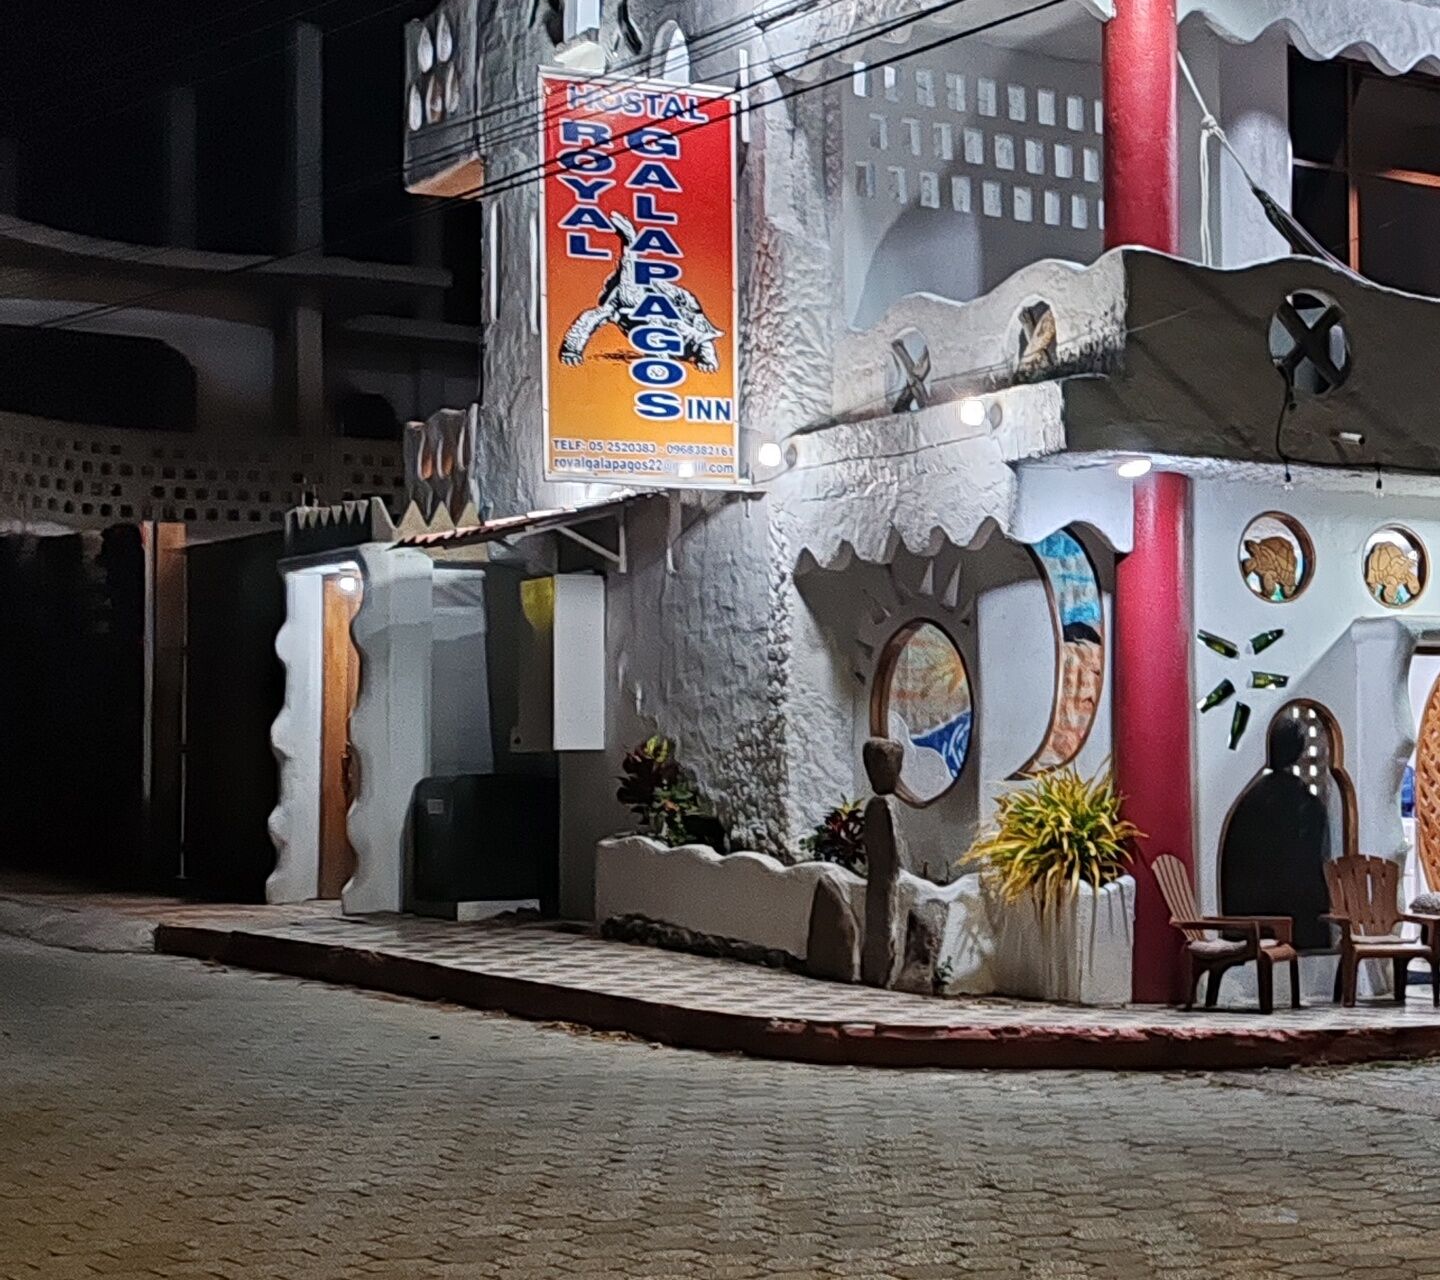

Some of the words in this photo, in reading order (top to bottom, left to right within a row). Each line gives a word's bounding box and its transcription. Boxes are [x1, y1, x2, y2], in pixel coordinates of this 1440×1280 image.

[568, 84, 708, 123] HOSTAL
[557, 119, 616, 260] ROYAL
[625, 128, 686, 420] GALAPAGOS
[686, 398, 732, 421] INN
[589, 441, 603, 451] 05
